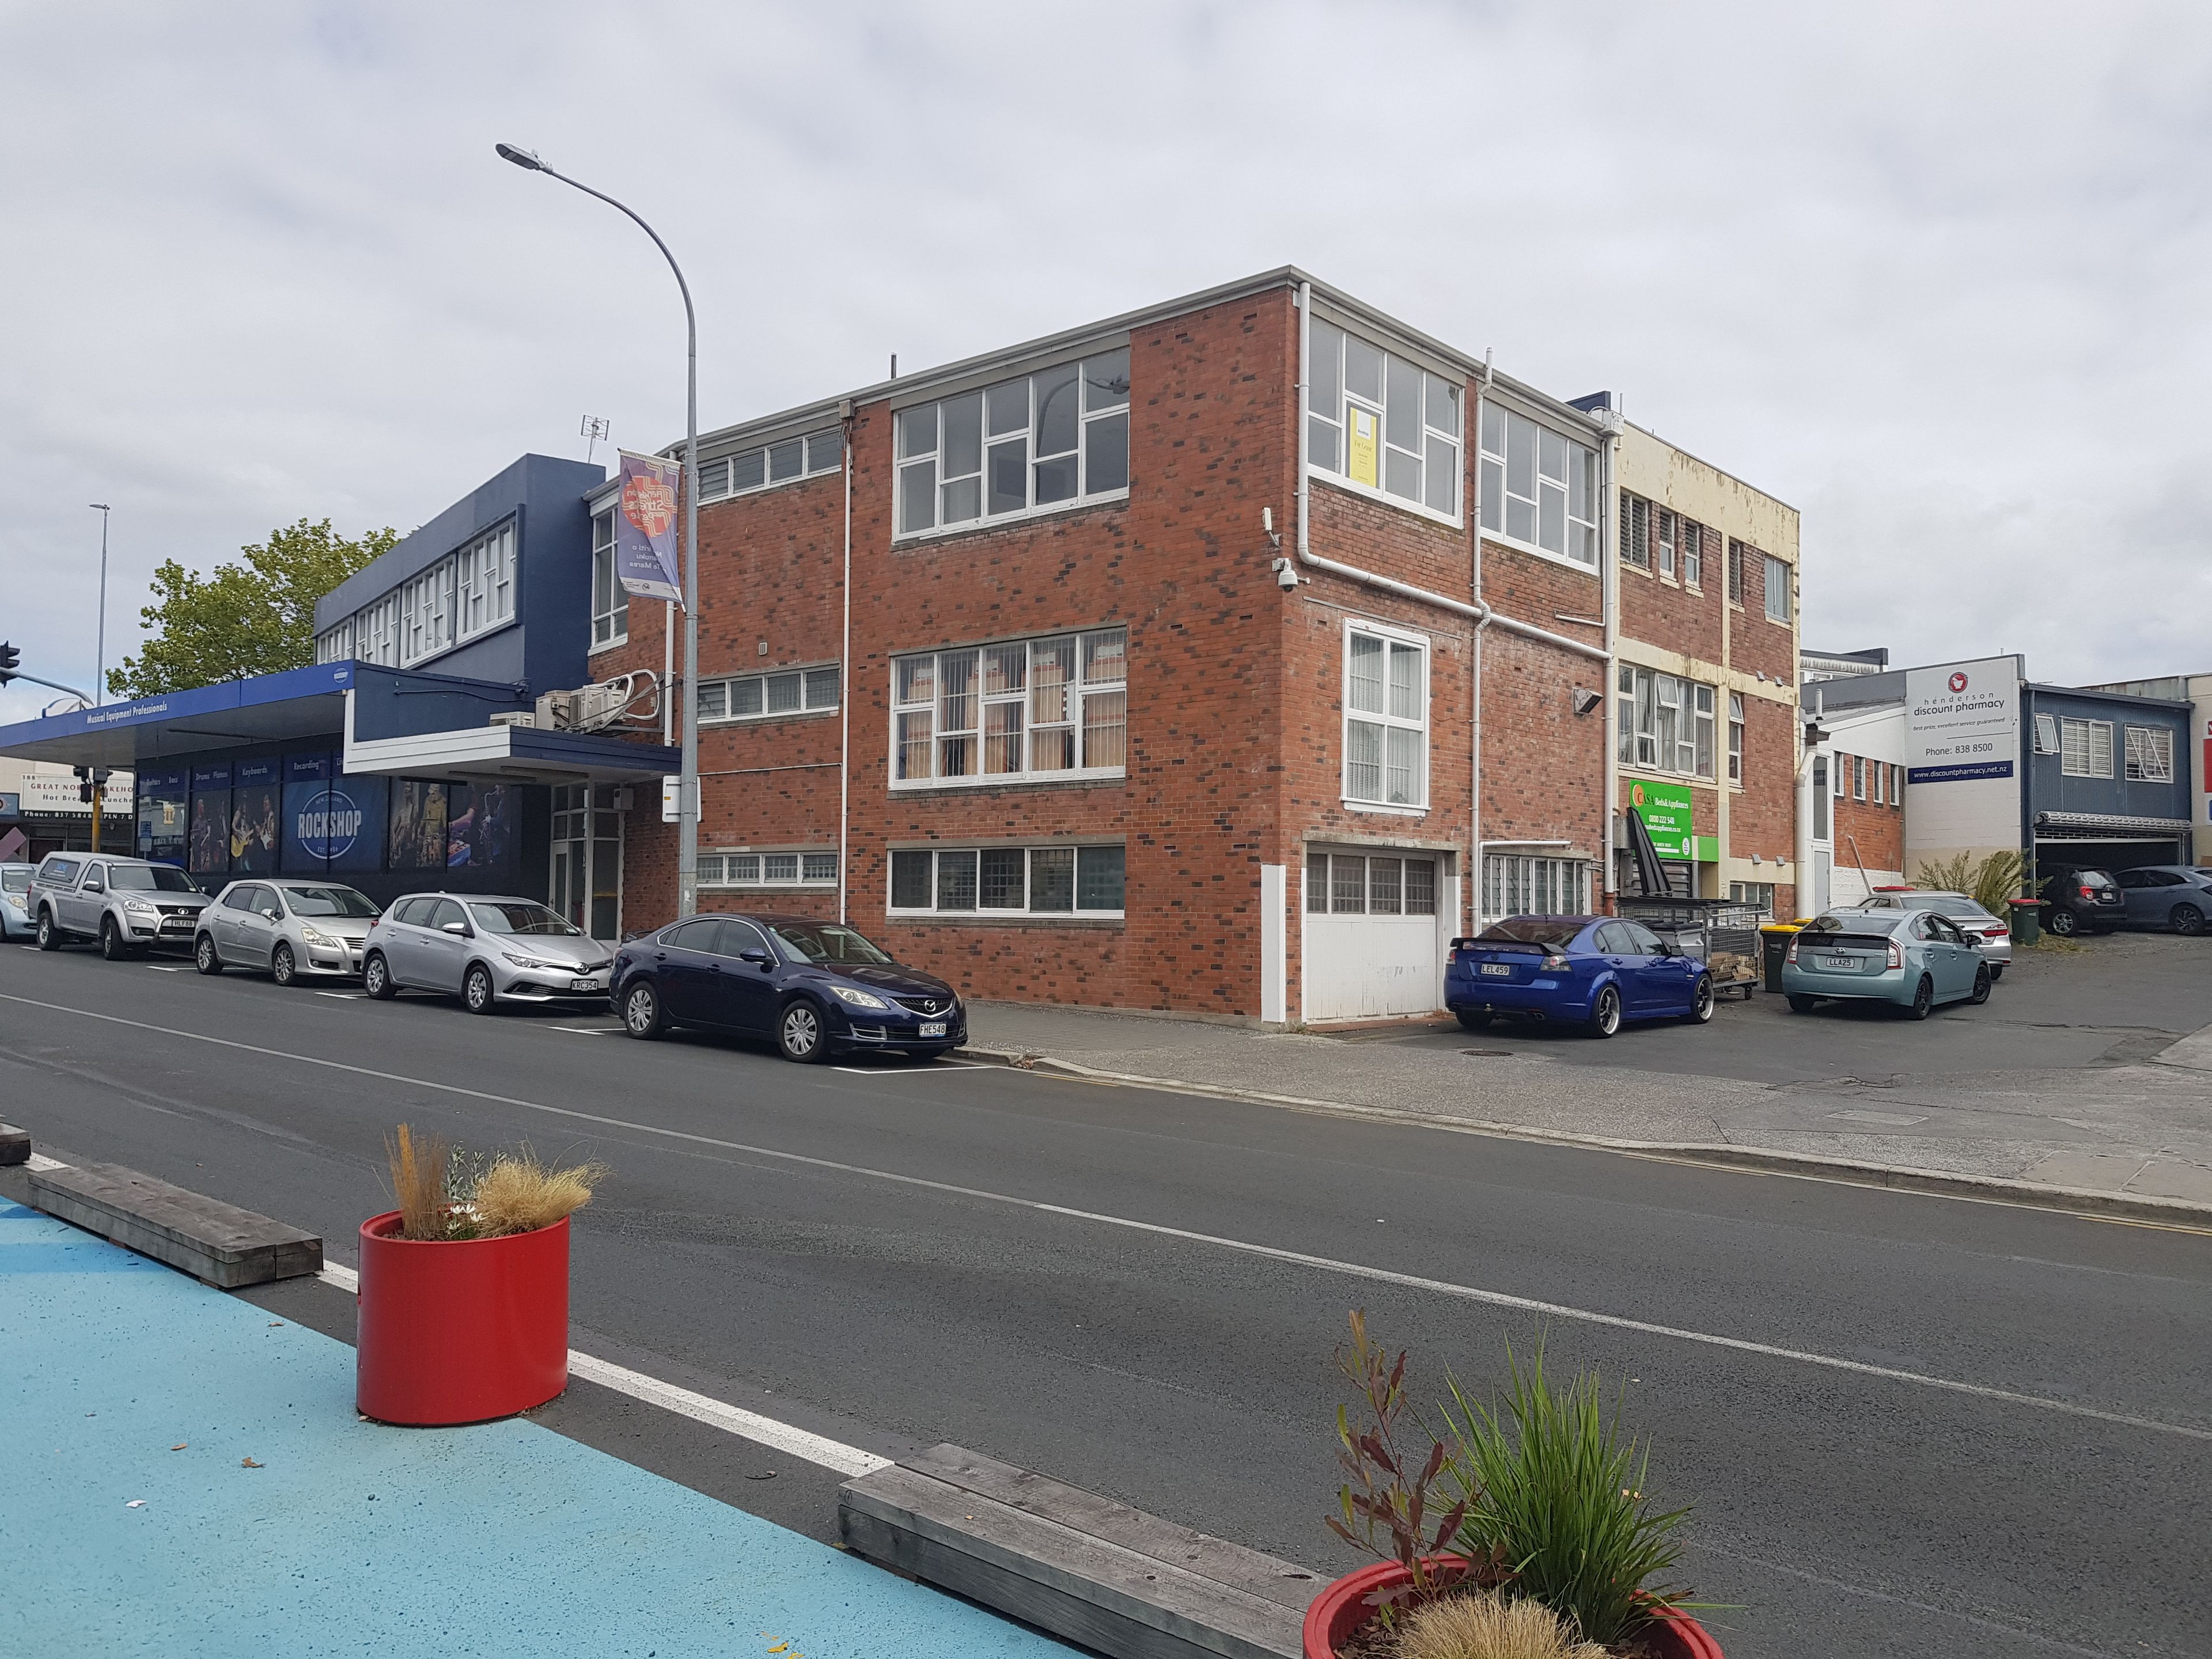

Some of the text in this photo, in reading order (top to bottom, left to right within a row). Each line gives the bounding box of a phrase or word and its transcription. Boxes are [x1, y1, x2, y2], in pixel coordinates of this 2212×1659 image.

[1924, 692, 1994, 705] henderson
[87, 700, 168, 724] Musical Equipment Professionals
[1914, 700, 2005, 715] discount pharmacy
[1926, 743, 1993, 756] Phone: 838 8500
[242, 765, 268, 777] Keyboards
[294, 760, 320, 771] Recording
[1914, 766, 2008, 778] www.discountpharmacy.net.nz
[1637, 792, 1654, 805] CASA
[297, 809, 362, 839] ROCKSHOP
[1482, 965, 1509, 974] LEL459
[920, 1025, 945, 1034] FHE548
